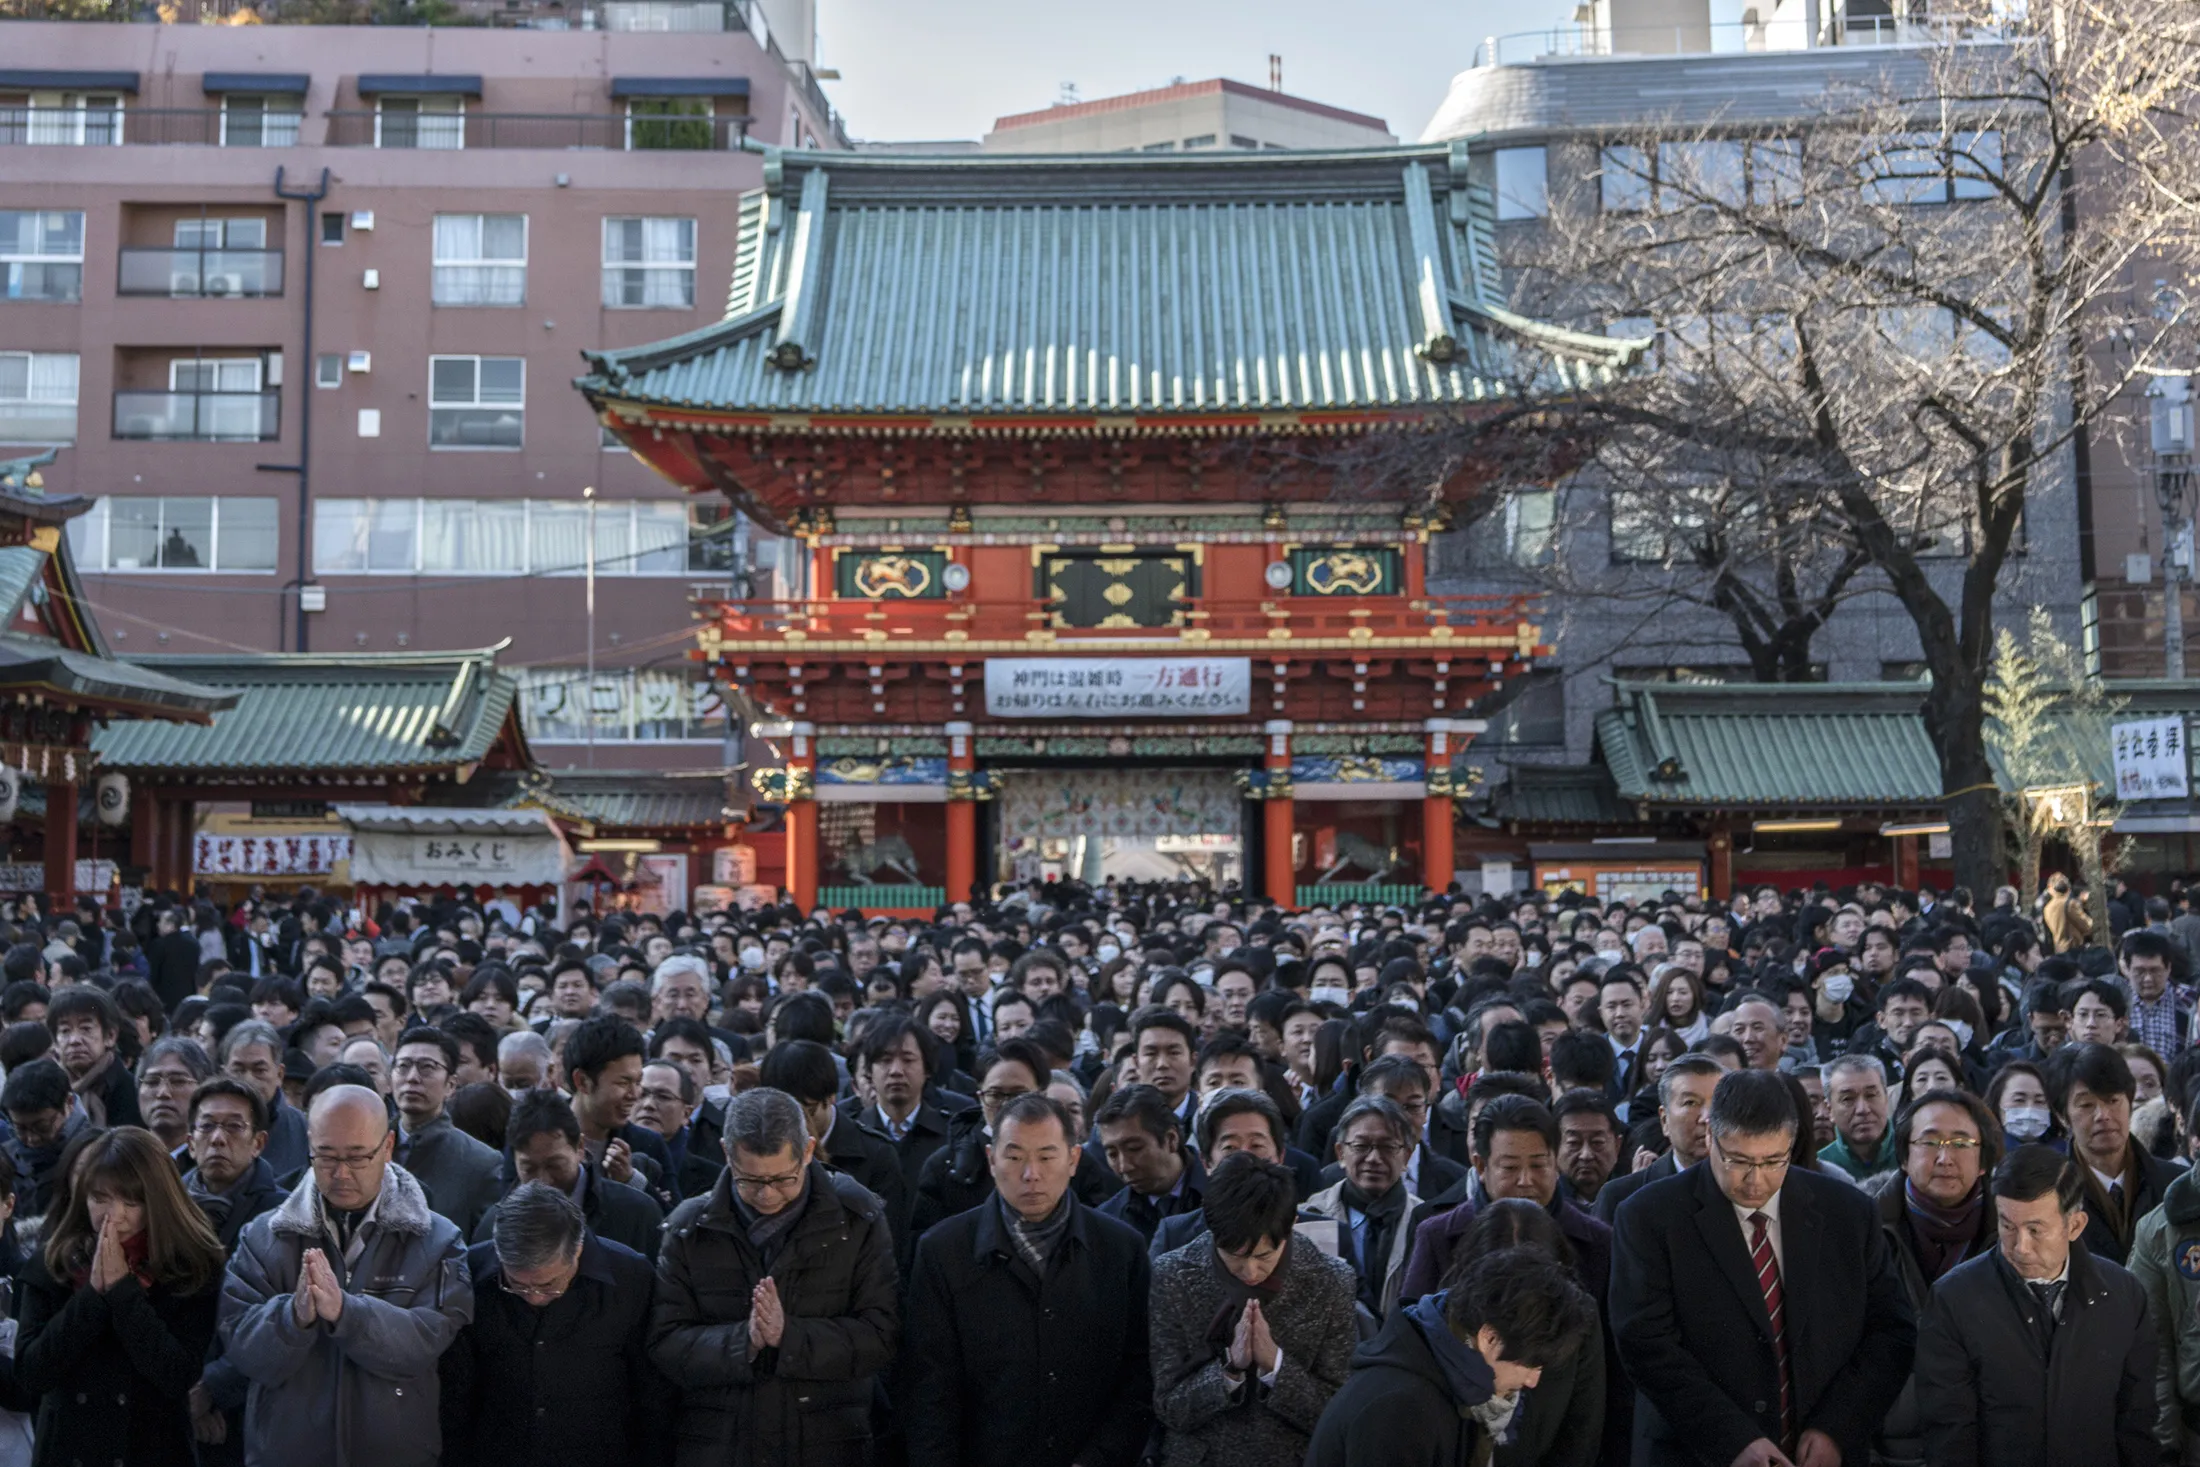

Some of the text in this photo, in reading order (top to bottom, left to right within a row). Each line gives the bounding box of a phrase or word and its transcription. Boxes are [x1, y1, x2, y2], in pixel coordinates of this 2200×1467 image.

[1012, 665, 1223, 688] 神門は混雑時 一方通行
[425, 841, 506, 861] おみくじ
